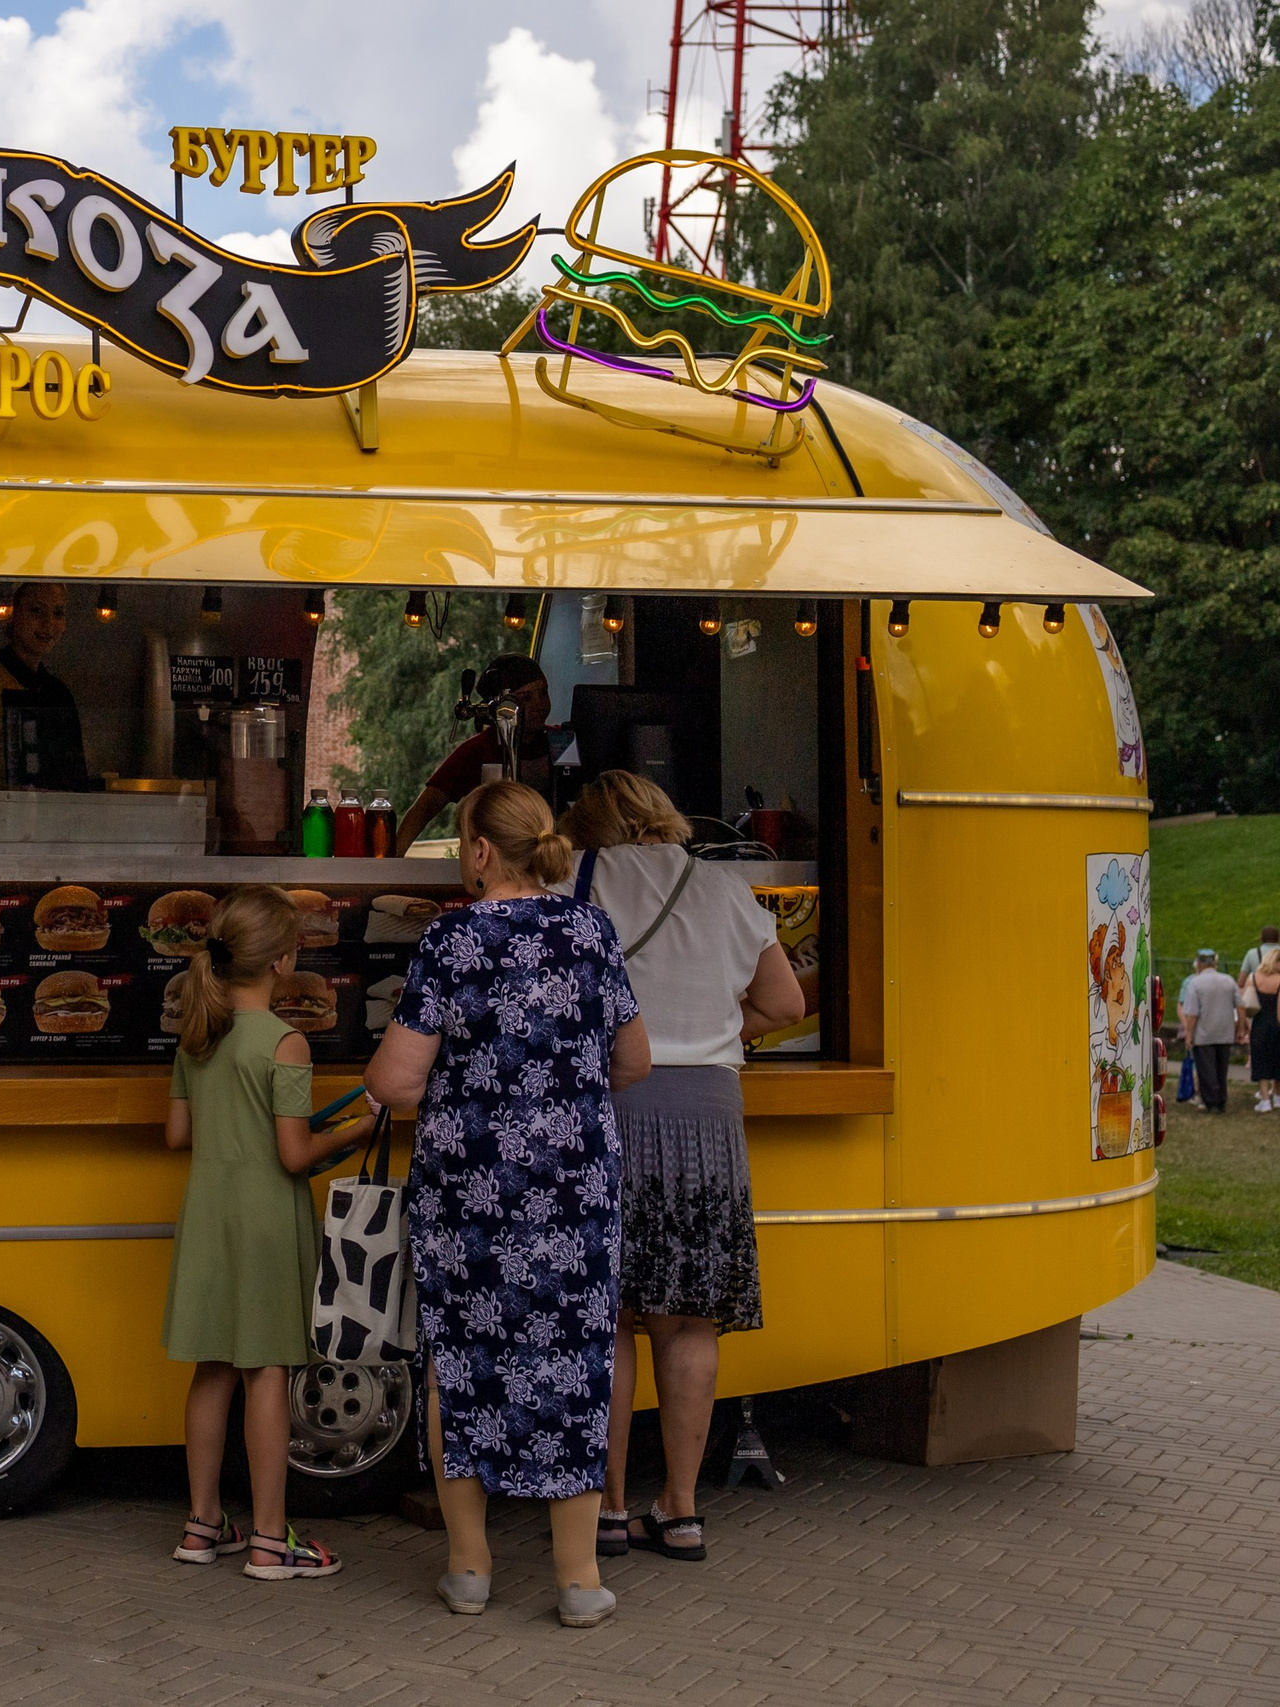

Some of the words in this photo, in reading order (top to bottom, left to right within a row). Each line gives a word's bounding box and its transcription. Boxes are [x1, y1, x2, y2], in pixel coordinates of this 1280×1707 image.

[169, 125, 377, 196] БУРГЕР
[171, 666, 201, 675] ТАРХУН
[172, 684, 212, 693] АПЕЛЬСИН
